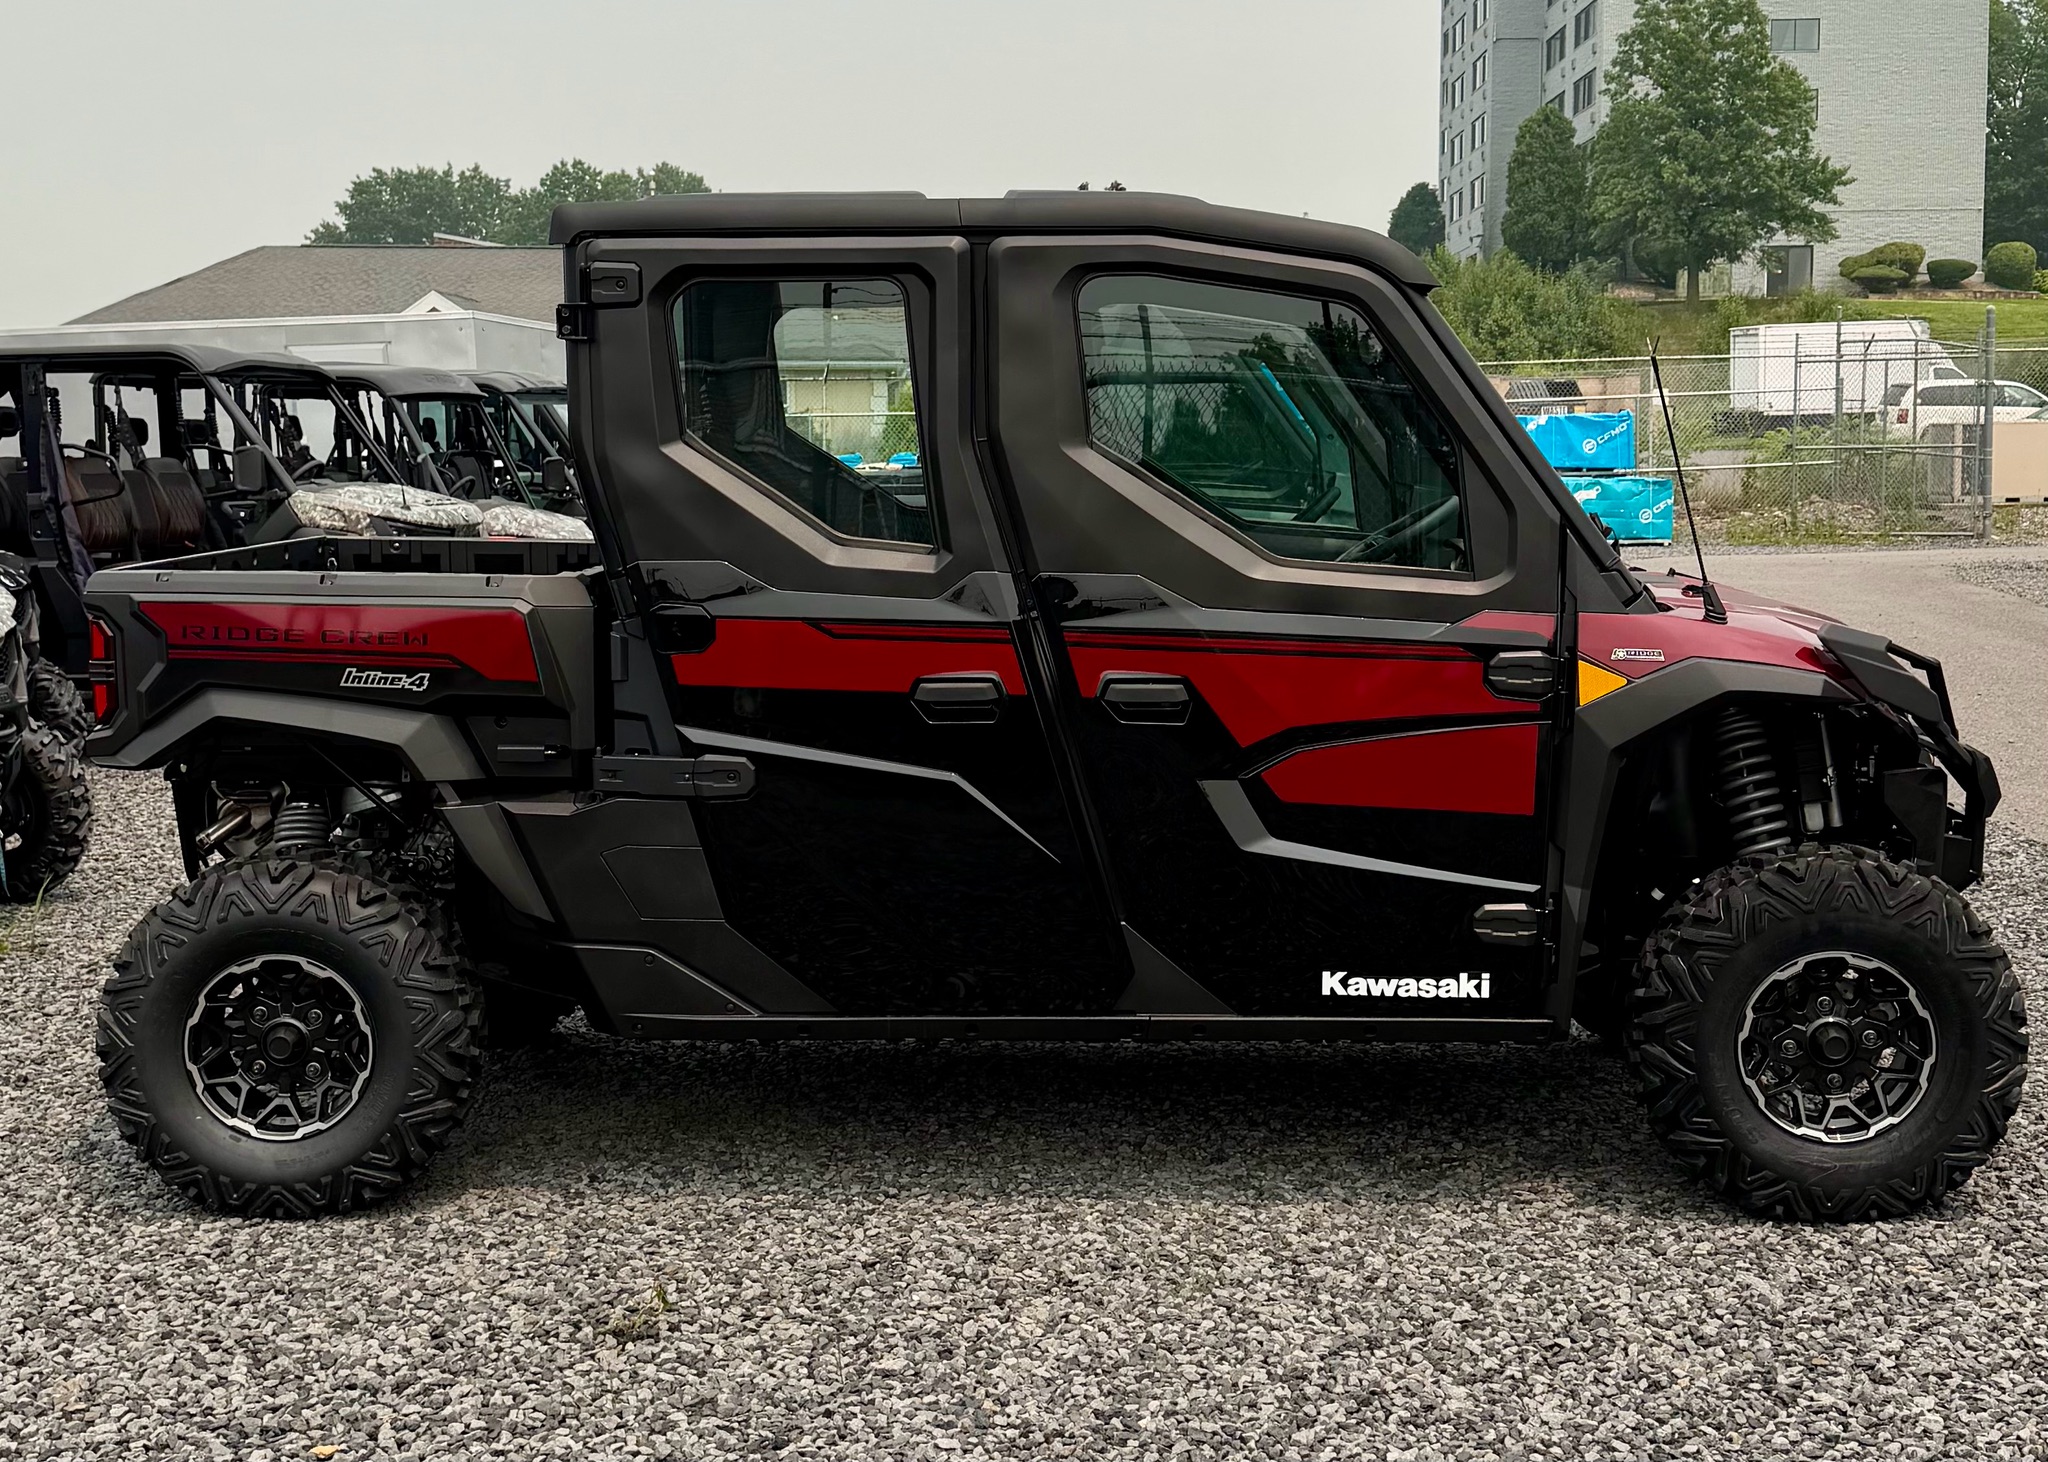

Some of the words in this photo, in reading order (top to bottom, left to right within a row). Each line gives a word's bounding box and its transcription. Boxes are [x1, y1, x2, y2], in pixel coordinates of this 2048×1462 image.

[182, 625, 305, 643] RIDGE
[320, 629, 428, 646] CREW
[340, 668, 430, 691] Inline-4
[1322, 971, 1491, 999] Kawasaki
